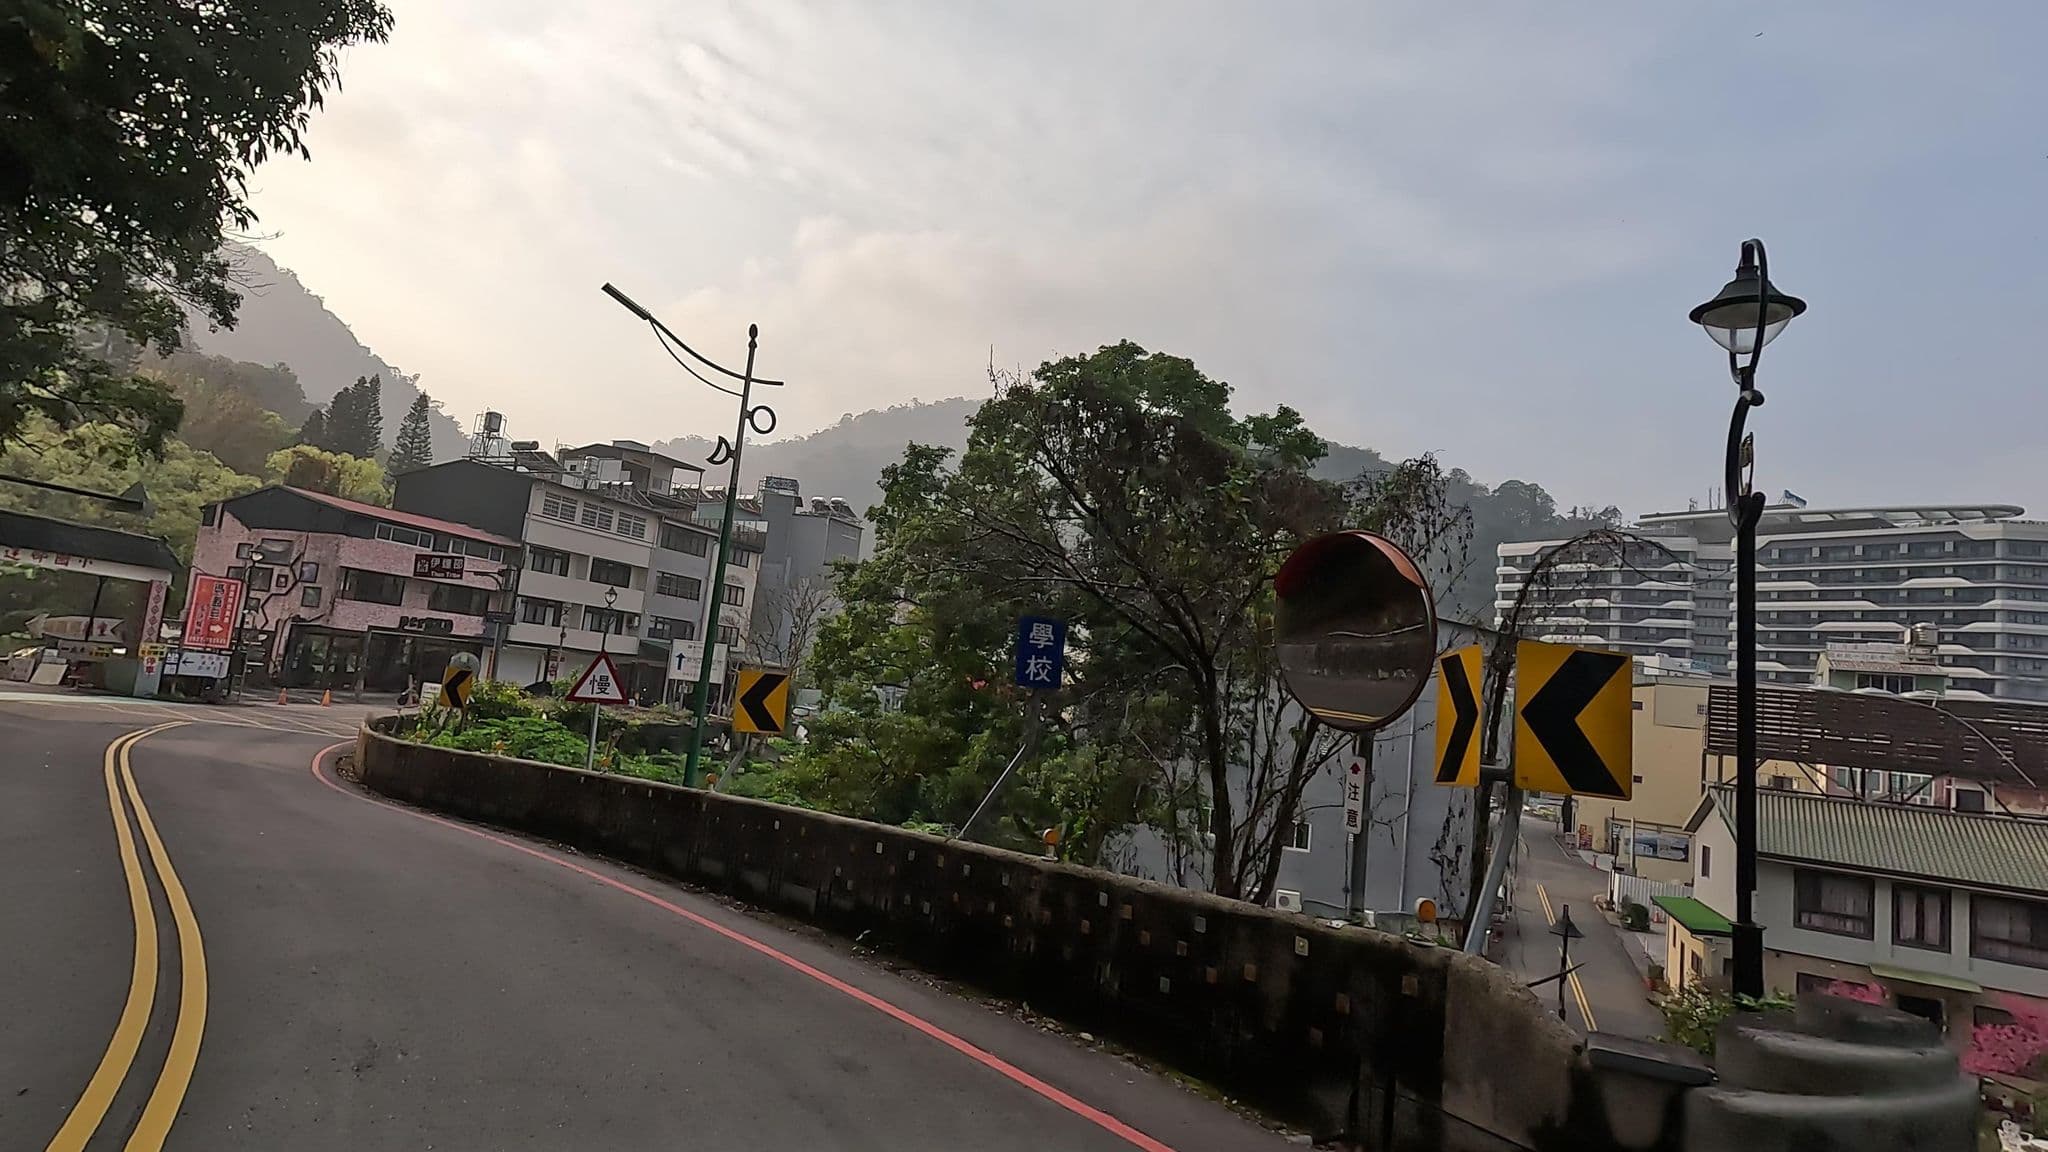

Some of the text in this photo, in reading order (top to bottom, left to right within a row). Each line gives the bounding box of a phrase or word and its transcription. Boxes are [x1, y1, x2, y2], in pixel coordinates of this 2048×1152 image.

[1025, 622, 1055, 683] 學校
[589, 674, 611, 695] 慢
[1345, 782, 1360, 829] 注意
